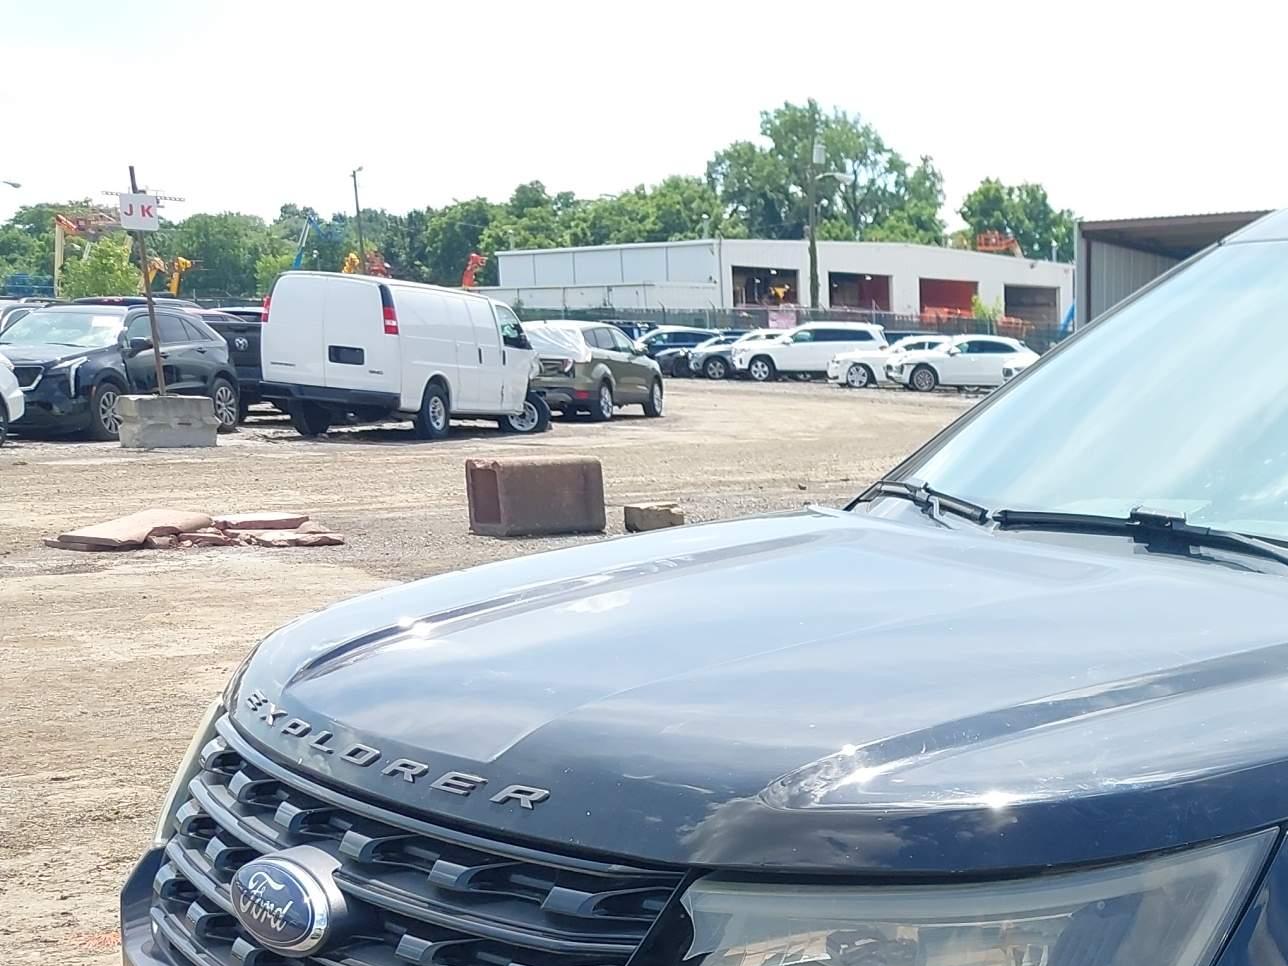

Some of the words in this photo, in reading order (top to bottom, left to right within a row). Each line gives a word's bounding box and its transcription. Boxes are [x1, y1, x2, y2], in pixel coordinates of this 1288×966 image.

[123, 203, 134, 217] J
[140, 204, 154, 218] K
[246, 688, 550, 810] EXPLORER
[240, 871, 294, 931] Ford
